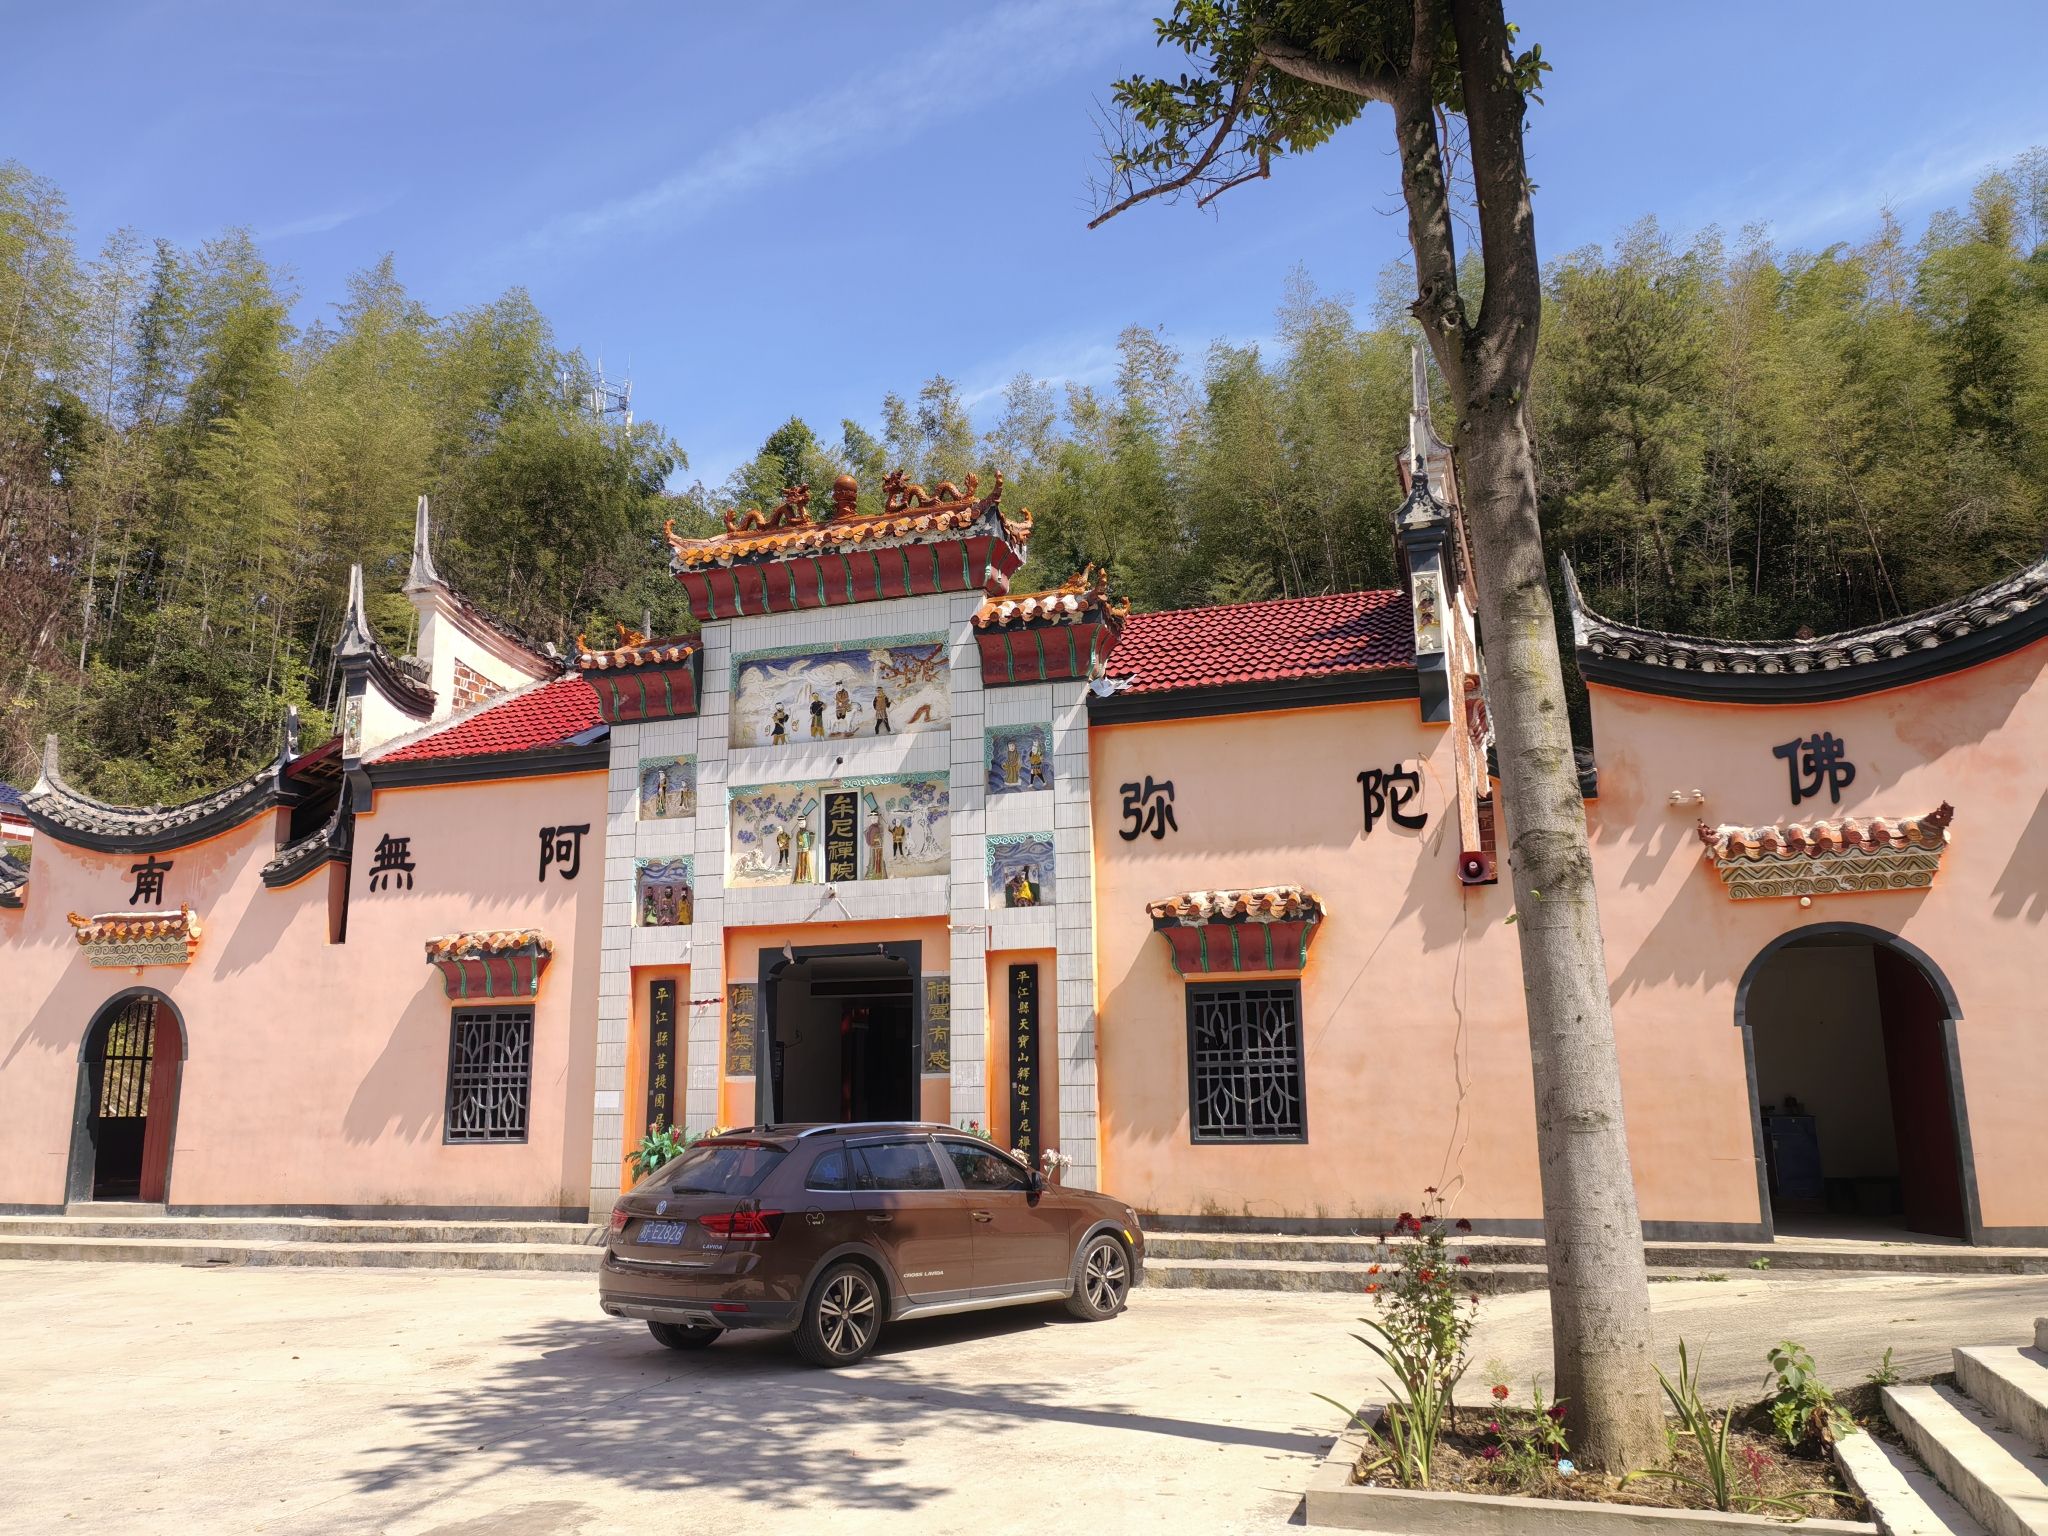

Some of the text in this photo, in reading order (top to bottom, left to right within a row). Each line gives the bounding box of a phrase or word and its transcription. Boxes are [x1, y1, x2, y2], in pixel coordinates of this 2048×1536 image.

[1357, 764, 1428, 833] 陀
[1772, 732, 1856, 806] 佛
[827, 795, 856, 881] 牟尼禪院
[1119, 776, 1178, 841] 弥
[129, 856, 174, 906] 南
[369, 833, 416, 892] 無
[539, 824, 590, 882] 阿
